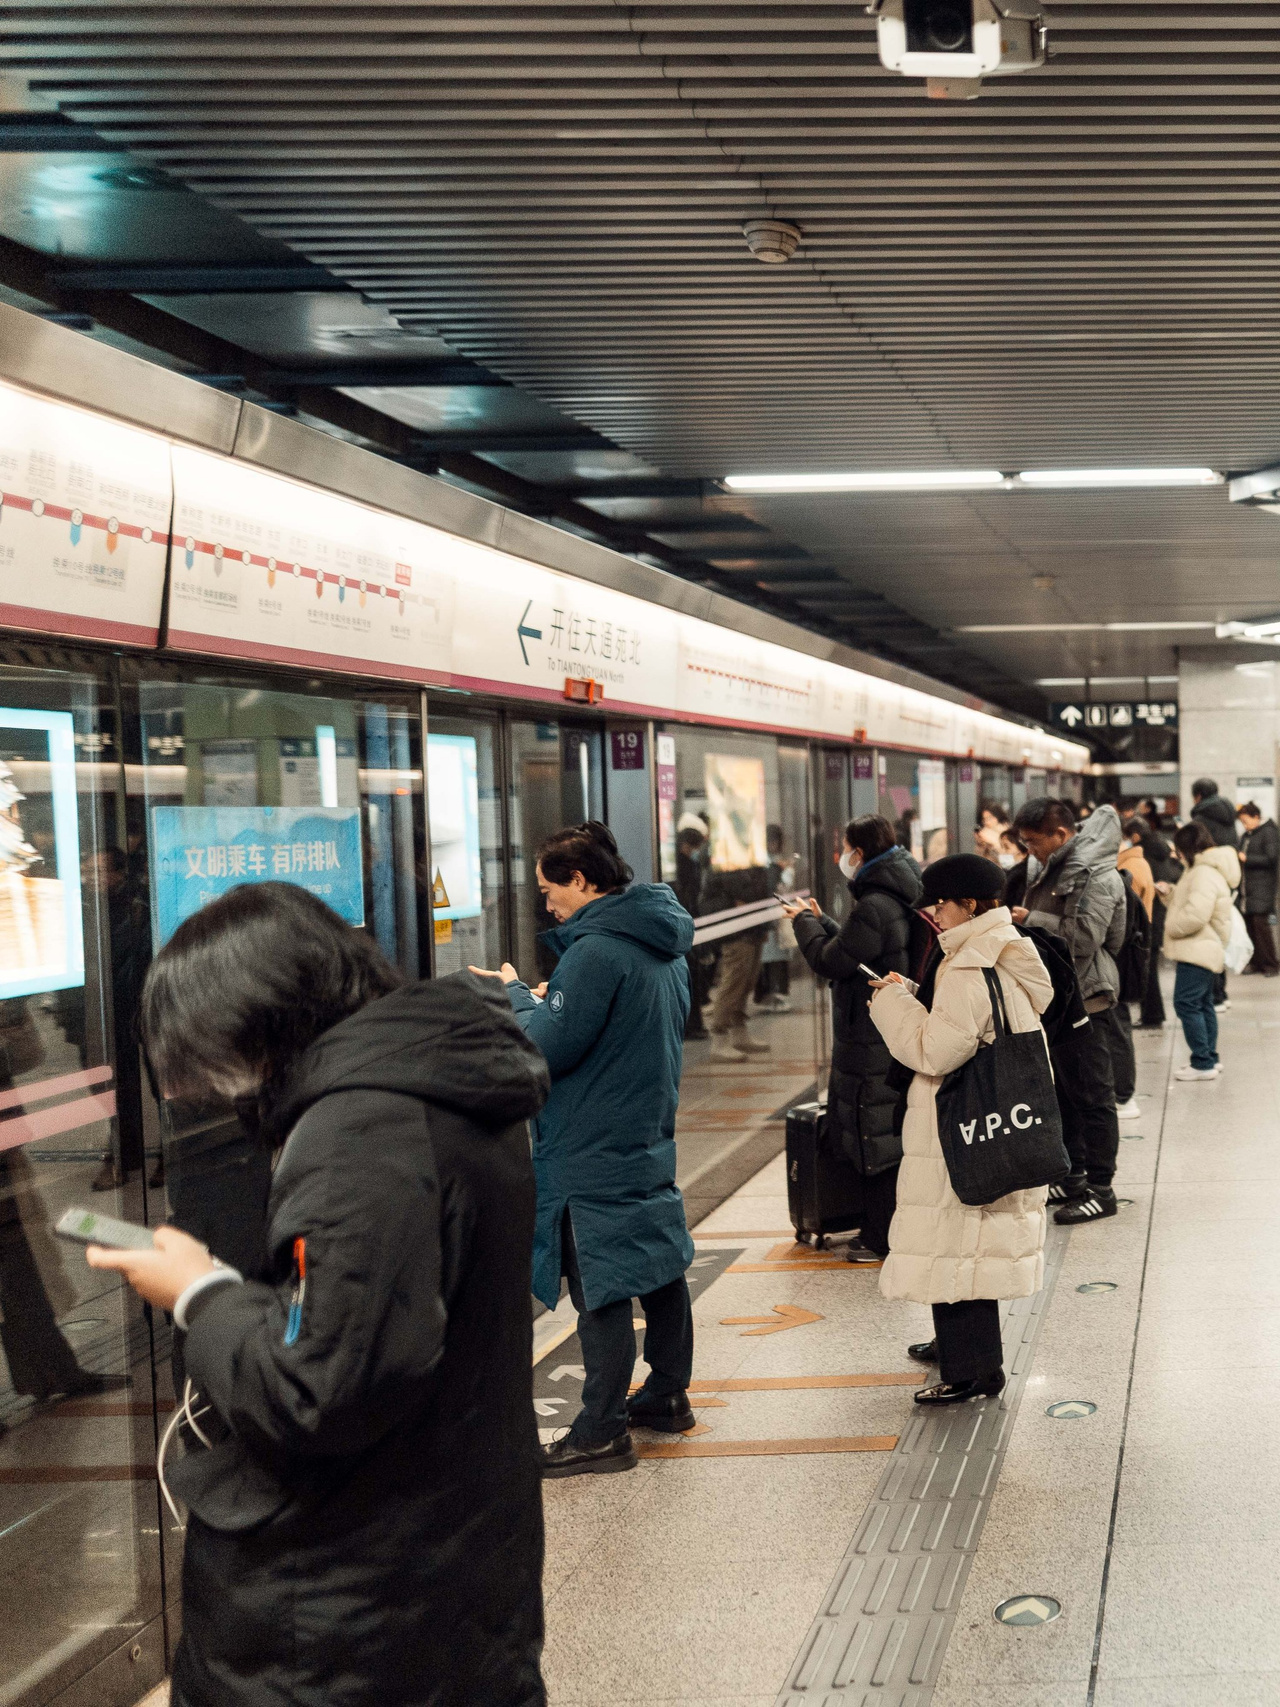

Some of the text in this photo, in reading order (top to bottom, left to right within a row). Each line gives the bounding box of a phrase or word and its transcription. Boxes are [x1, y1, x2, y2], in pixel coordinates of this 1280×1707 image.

[550, 608, 641, 666] 开往天通苑北
[547, 656, 556, 671] To
[557, 658, 608, 680] TIANTONGYUAN
[617, 732, 638, 749] 19
[185, 841, 341, 879] 文明乘车 有序排队
[958, 1103, 1043, 1146] A.P.C.
